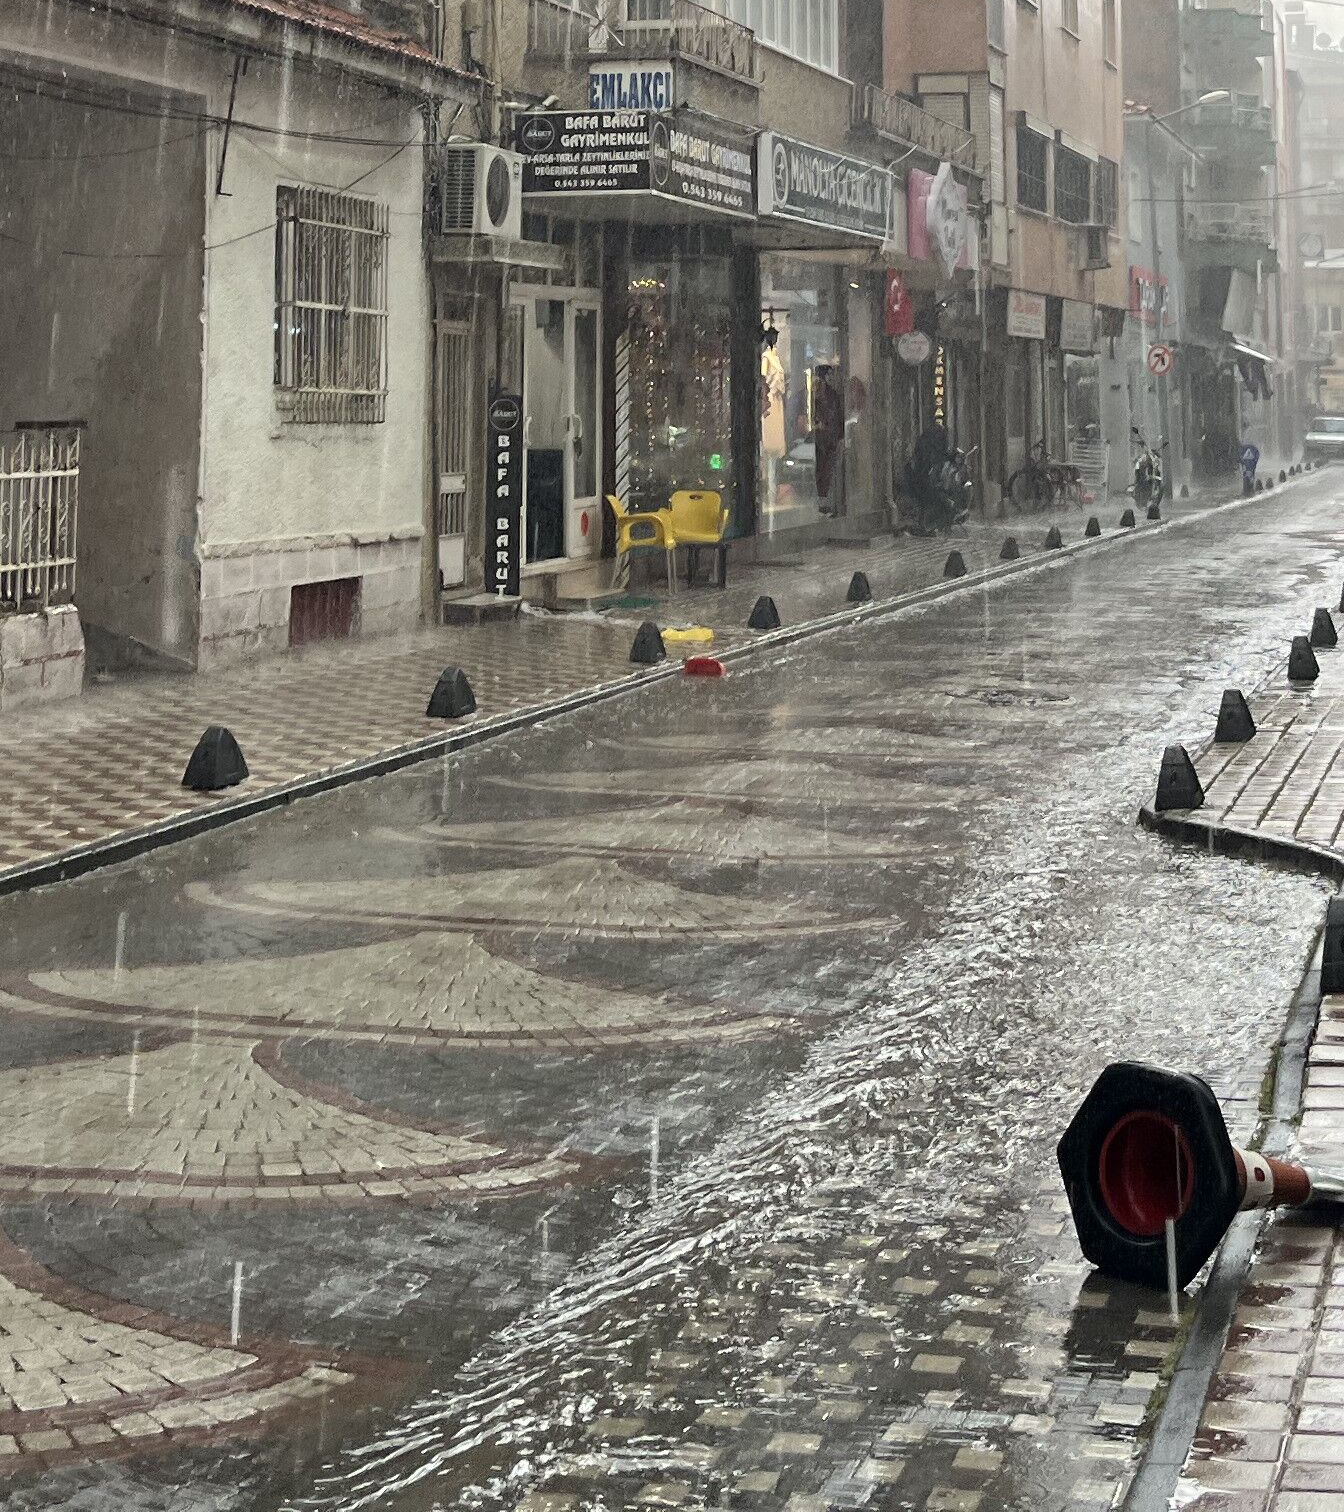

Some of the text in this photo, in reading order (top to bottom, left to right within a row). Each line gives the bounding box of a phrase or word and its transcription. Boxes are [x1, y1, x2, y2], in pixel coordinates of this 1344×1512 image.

[560, 131, 650, 148] GAYRİMENKUL
[565, 116, 599, 130] BAFA
[496, 435, 511, 498] BAFA
[495, 517, 510, 600] BARUT
